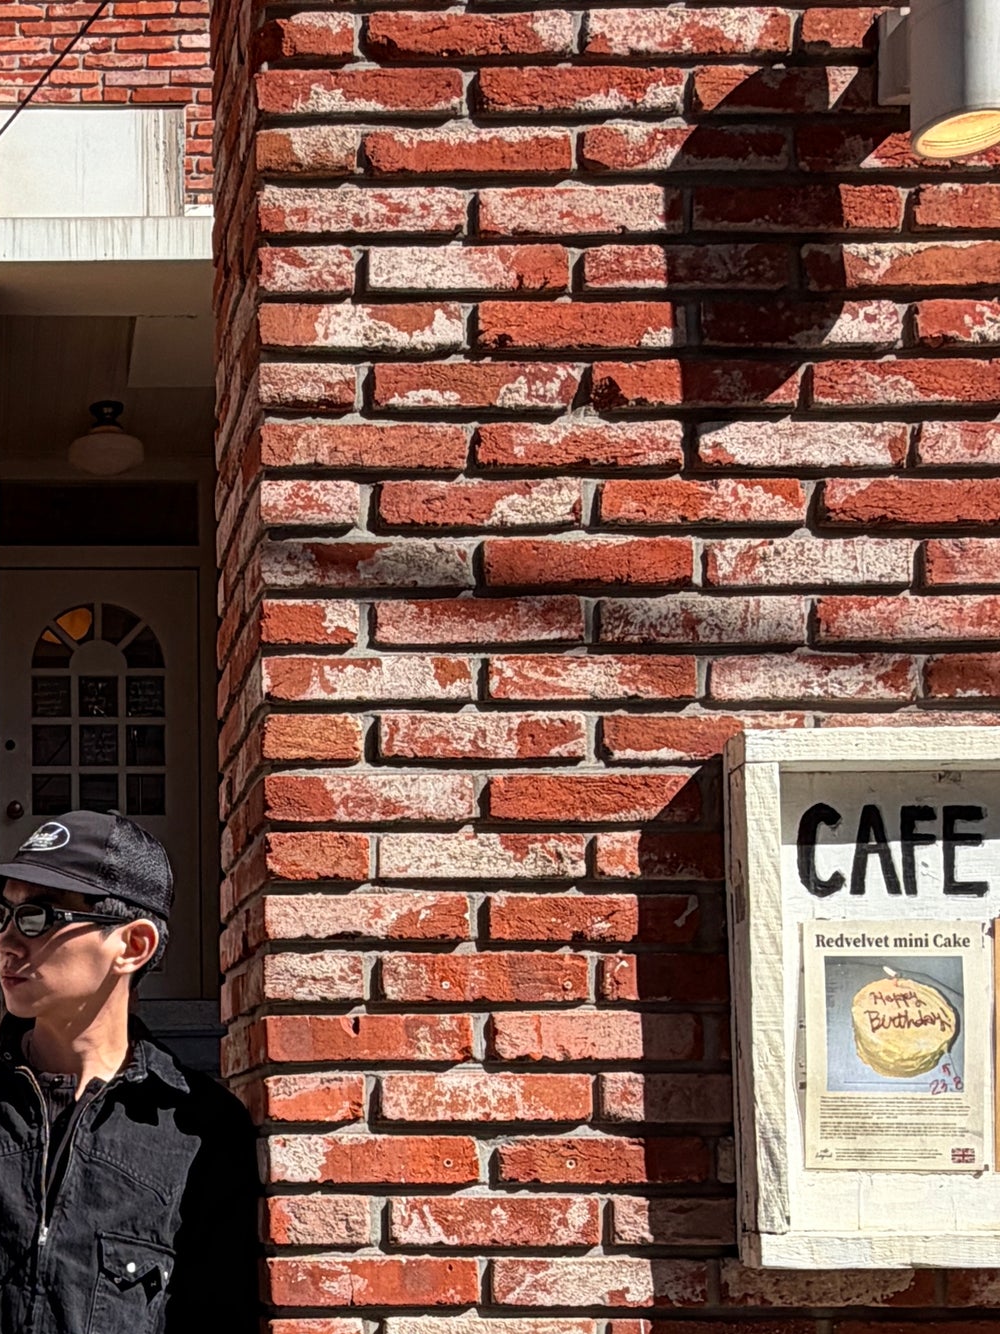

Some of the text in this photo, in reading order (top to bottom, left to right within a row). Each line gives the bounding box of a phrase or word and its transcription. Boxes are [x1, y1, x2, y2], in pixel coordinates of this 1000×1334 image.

[796, 802, 990, 898] CAFE
[815, 933, 971, 948] Redvelvet mini Cake
[868, 990, 927, 1009] Happy
[863, 1007, 953, 1033] Birthday!
